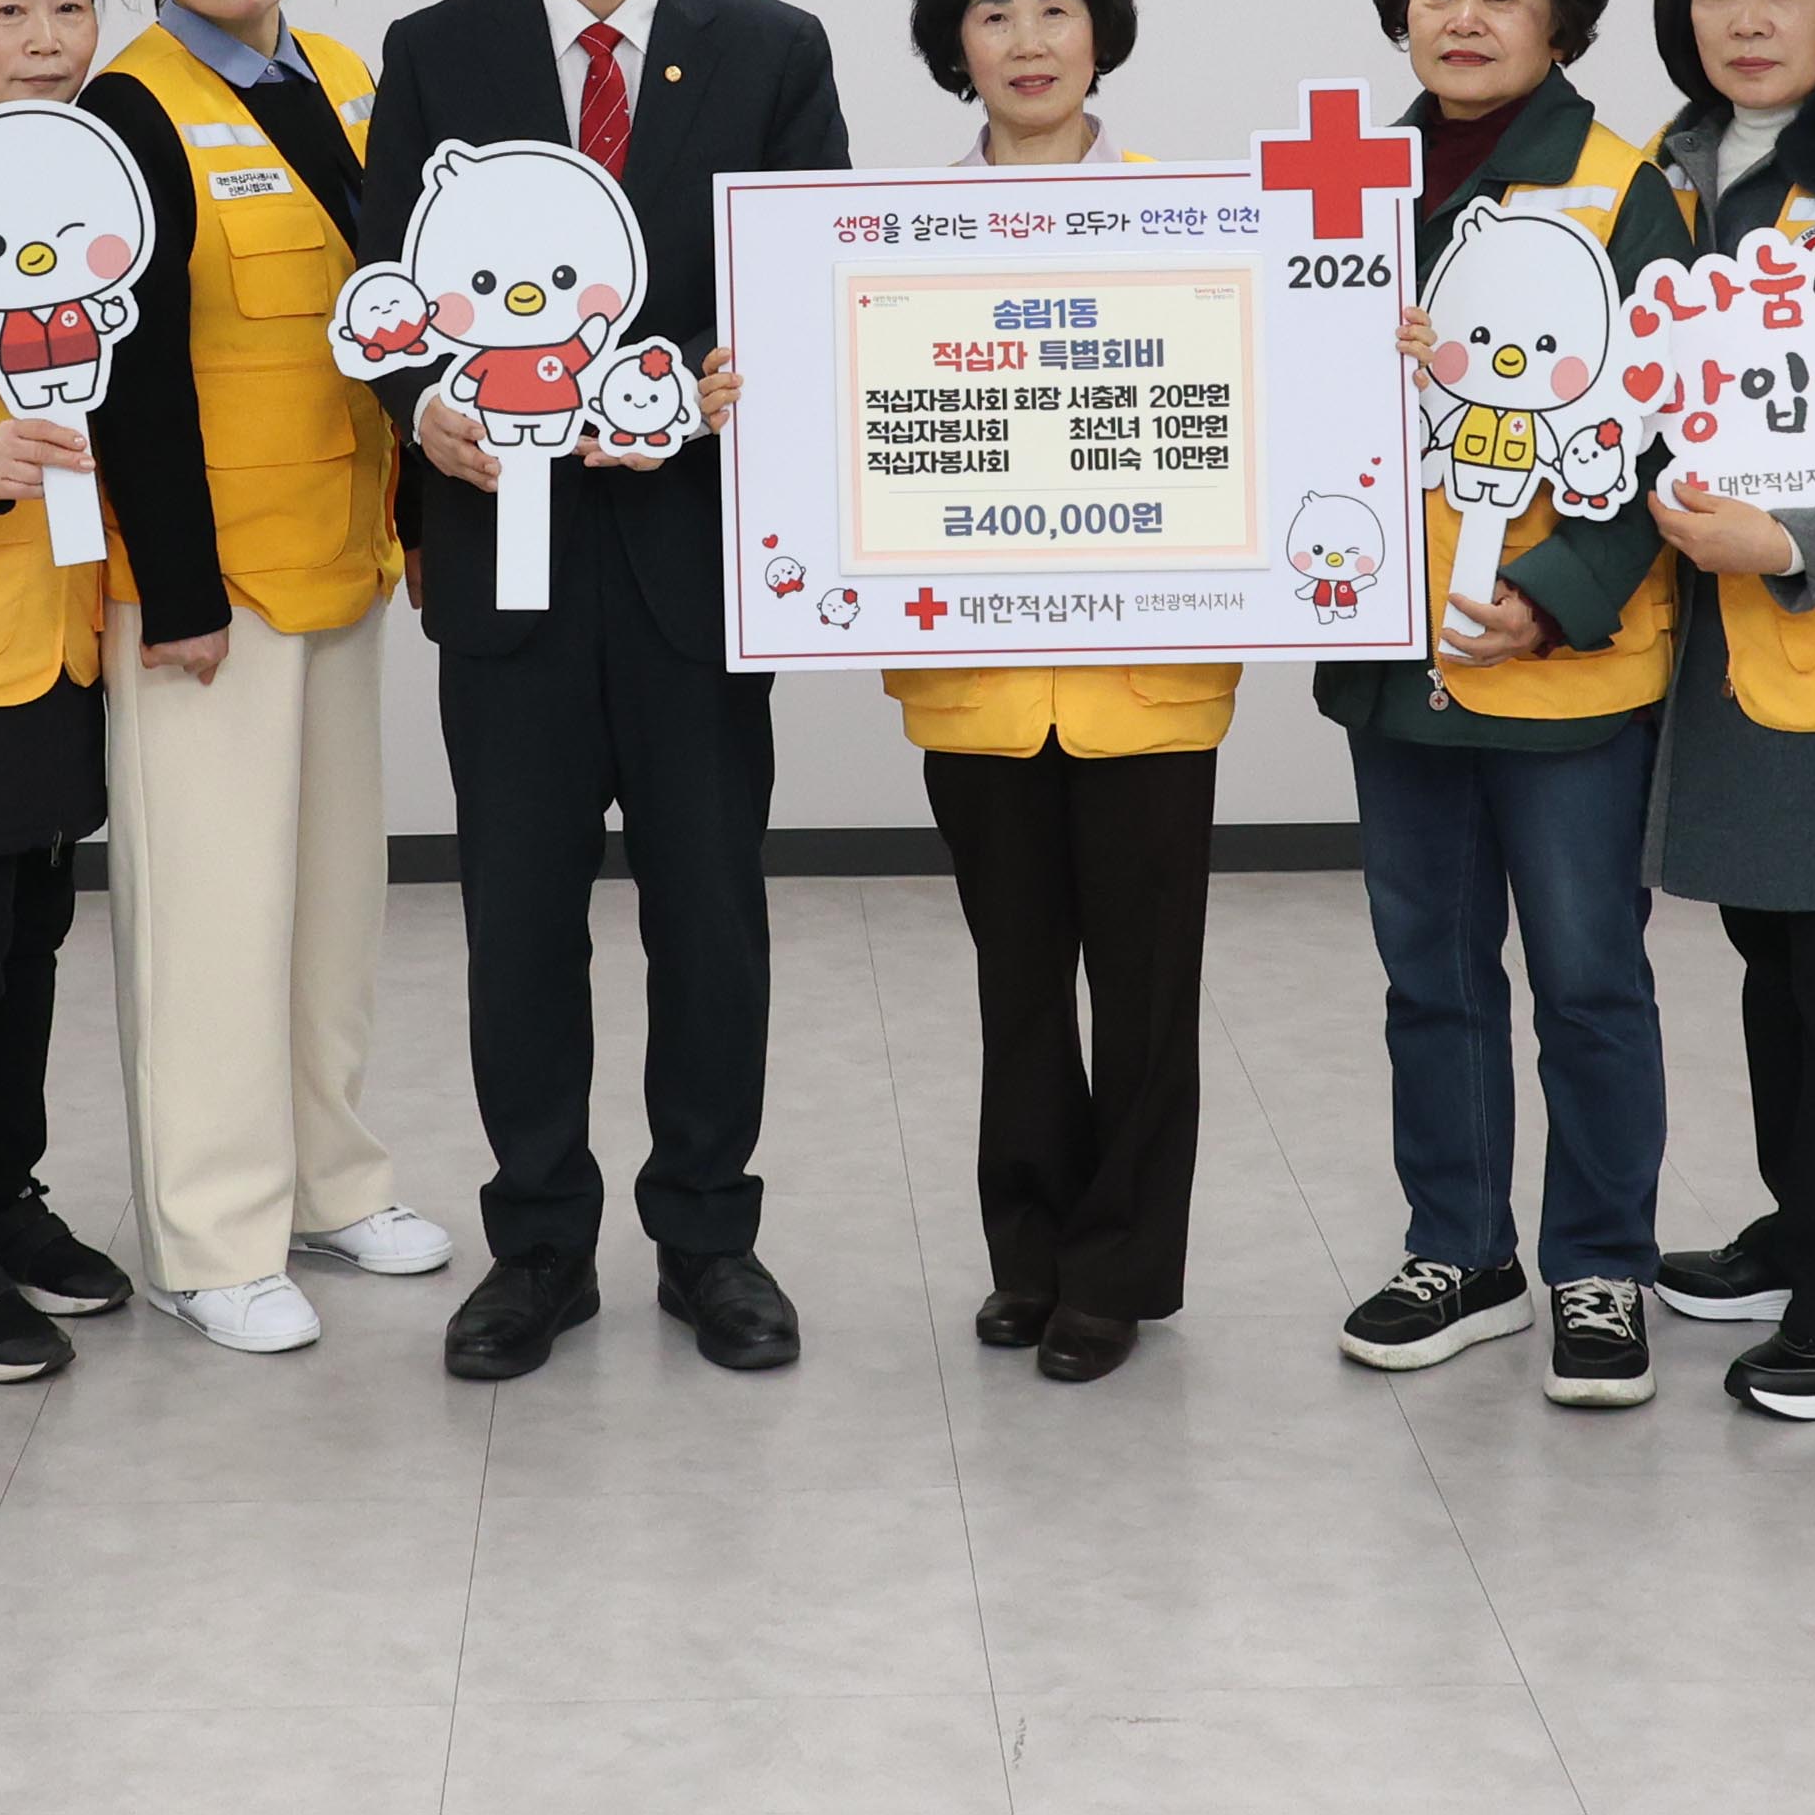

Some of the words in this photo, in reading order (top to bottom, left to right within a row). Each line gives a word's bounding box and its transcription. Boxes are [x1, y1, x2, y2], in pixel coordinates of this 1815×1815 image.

[833, 213, 902, 244] 생명을
[910, 212, 978, 241] 살리는
[987, 211, 1056, 239] 적십자
[1065, 210, 1131, 236] 모두가
[1139, 208, 1208, 236] 안전한
[1216, 206, 1261, 234] 인천
[1286, 254, 1392, 290] 2026
[992, 297, 1099, 331] 송림1동
[932, 340, 1028, 372] 적십자
[1038, 338, 1165, 371] 특별회비
[865, 388, 1008, 412] 적십자봉사회
[1014, 386, 1061, 411] 회장
[1067, 385, 1138, 410] 서충례
[1149, 384, 1231, 409] 20만원
[866, 419, 1009, 444] 적십자봉사회
[1069, 415, 1141, 441] 최선녀
[1152, 414, 1228, 440] 10만원
[867, 449, 1010, 475] 적십자봉사회
[1070, 447, 1142, 471] 이미숙
[1152, 445, 1229, 471] 10만원
[942, 502, 1164, 541] 금400,000원
[959, 593, 1125, 625] 대한적십자사
[1134, 592, 1246, 612] 인천광역시지사
